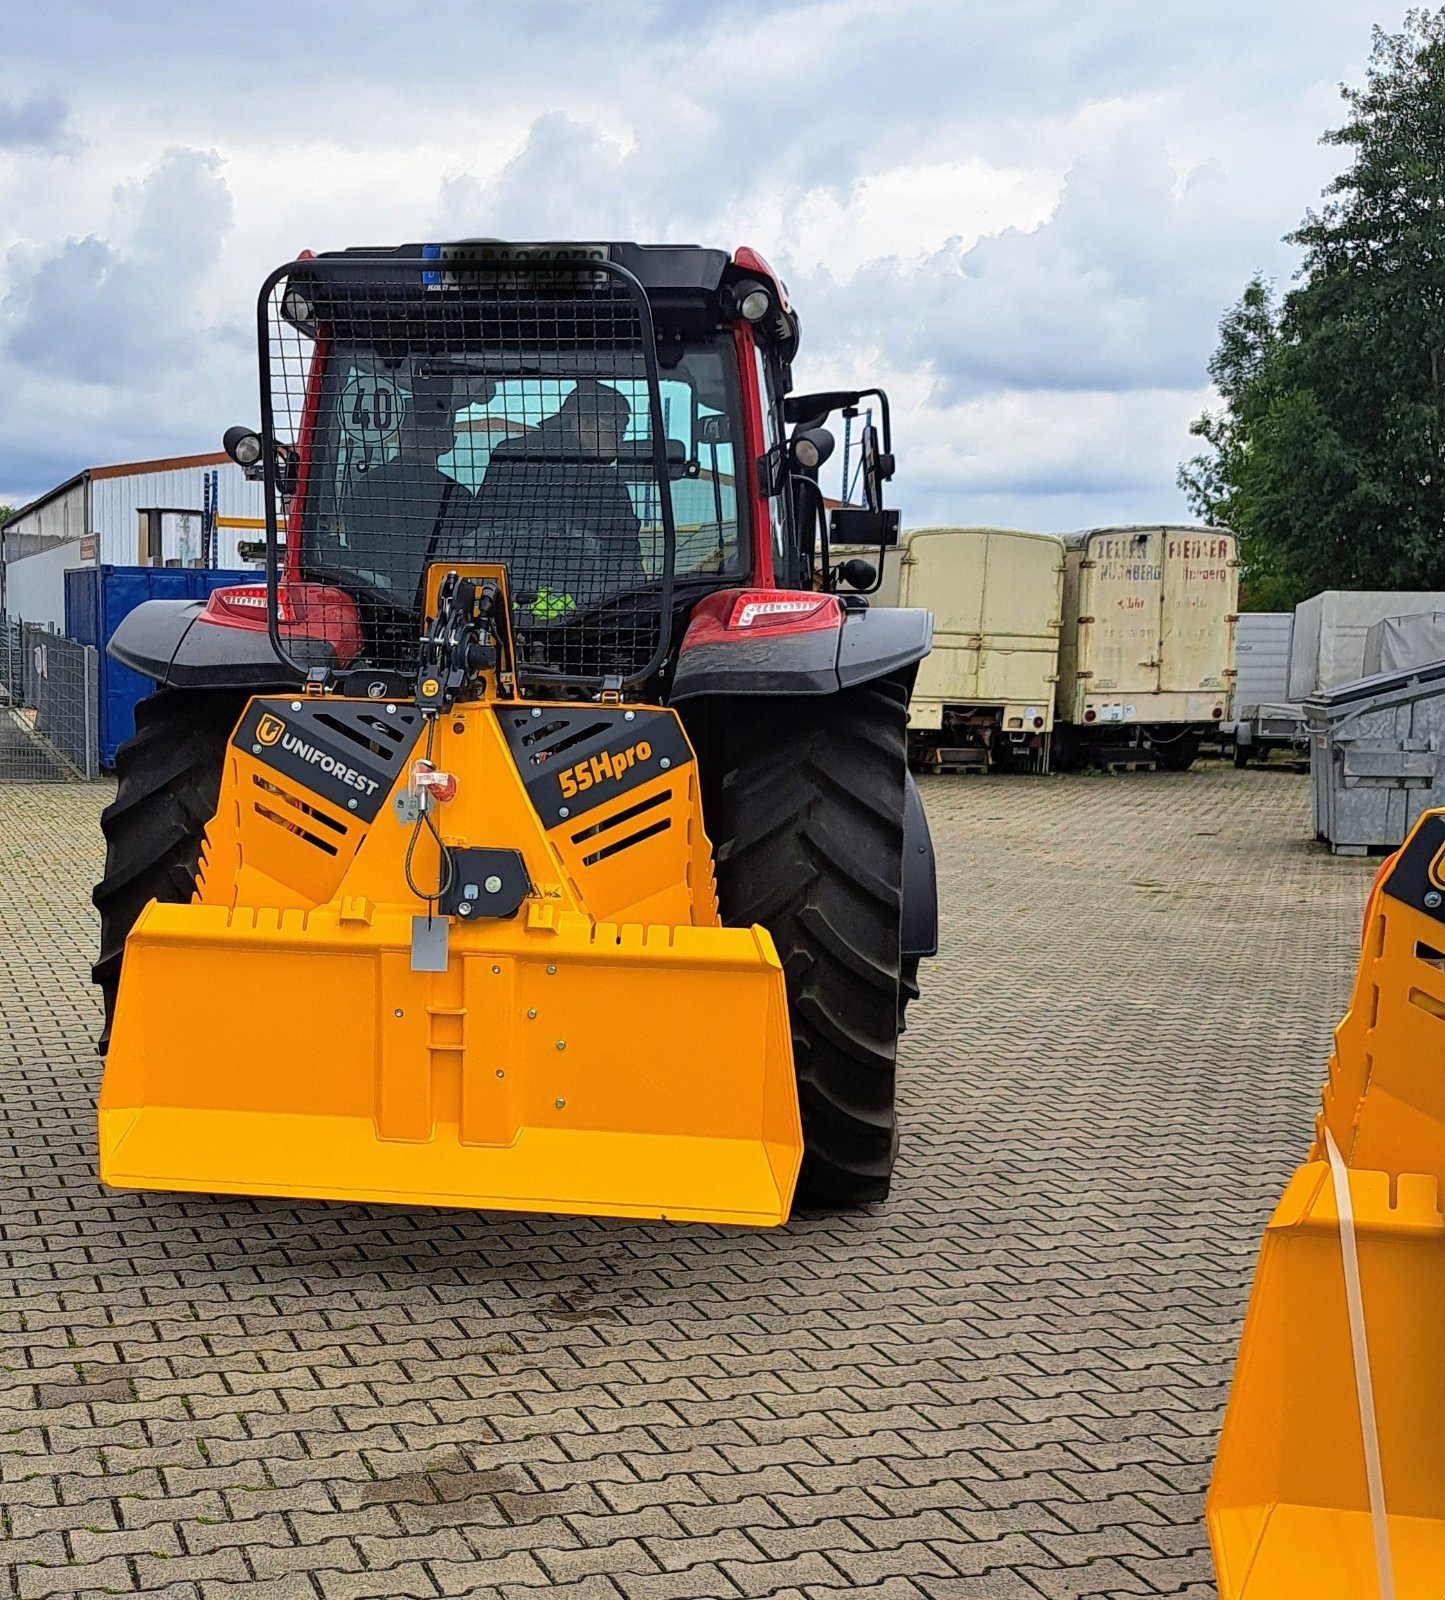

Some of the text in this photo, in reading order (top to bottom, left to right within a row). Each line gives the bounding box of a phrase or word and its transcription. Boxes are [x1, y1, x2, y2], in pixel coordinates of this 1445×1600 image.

[352, 388, 392, 429] 40
[281, 733, 380, 796] UNIFOREST
[558, 741, 652, 799] 55Hpro
